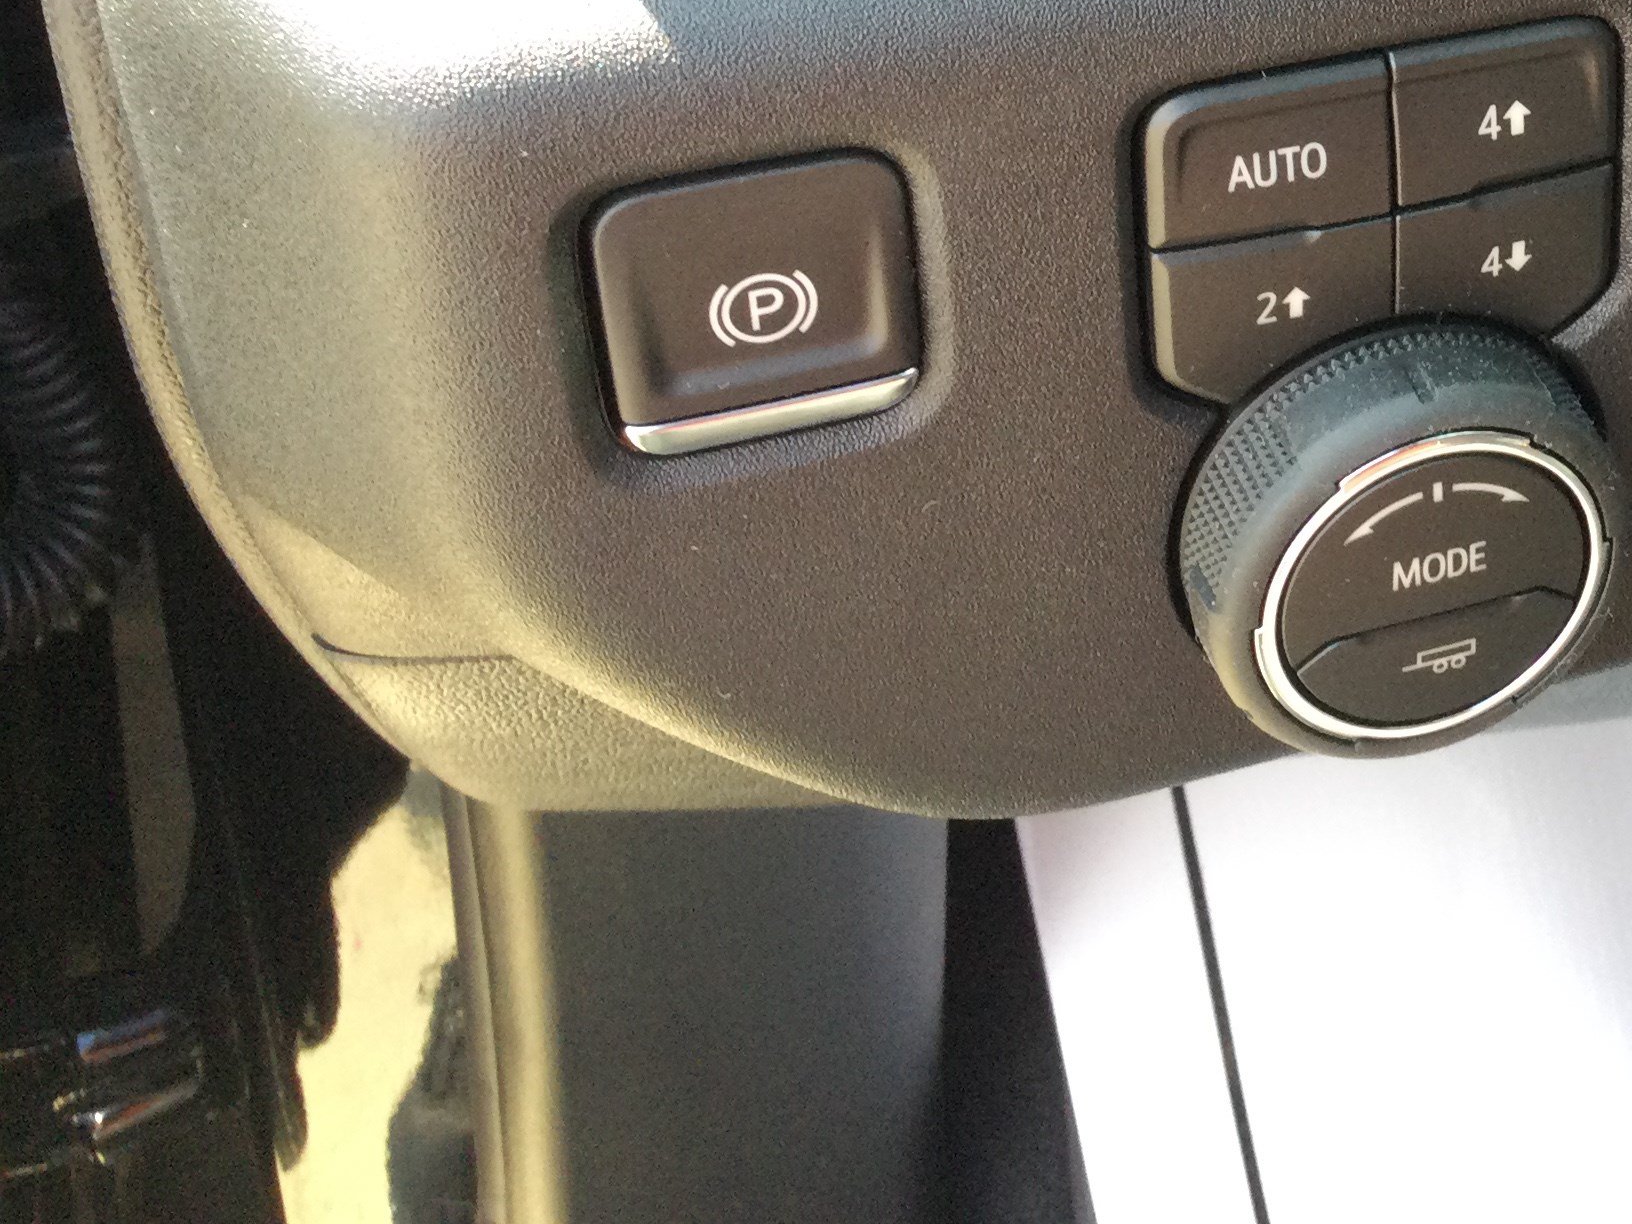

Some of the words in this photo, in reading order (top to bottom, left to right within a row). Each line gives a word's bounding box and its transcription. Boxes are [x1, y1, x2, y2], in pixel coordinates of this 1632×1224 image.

[1477, 104, 1502, 141] 4
[1227, 141, 1328, 193] AUTO
[1480, 245, 1503, 277] 4
[747, 286, 784, 331] P
[1256, 291, 1278, 325] 2
[1392, 540, 1487, 592] MODE
